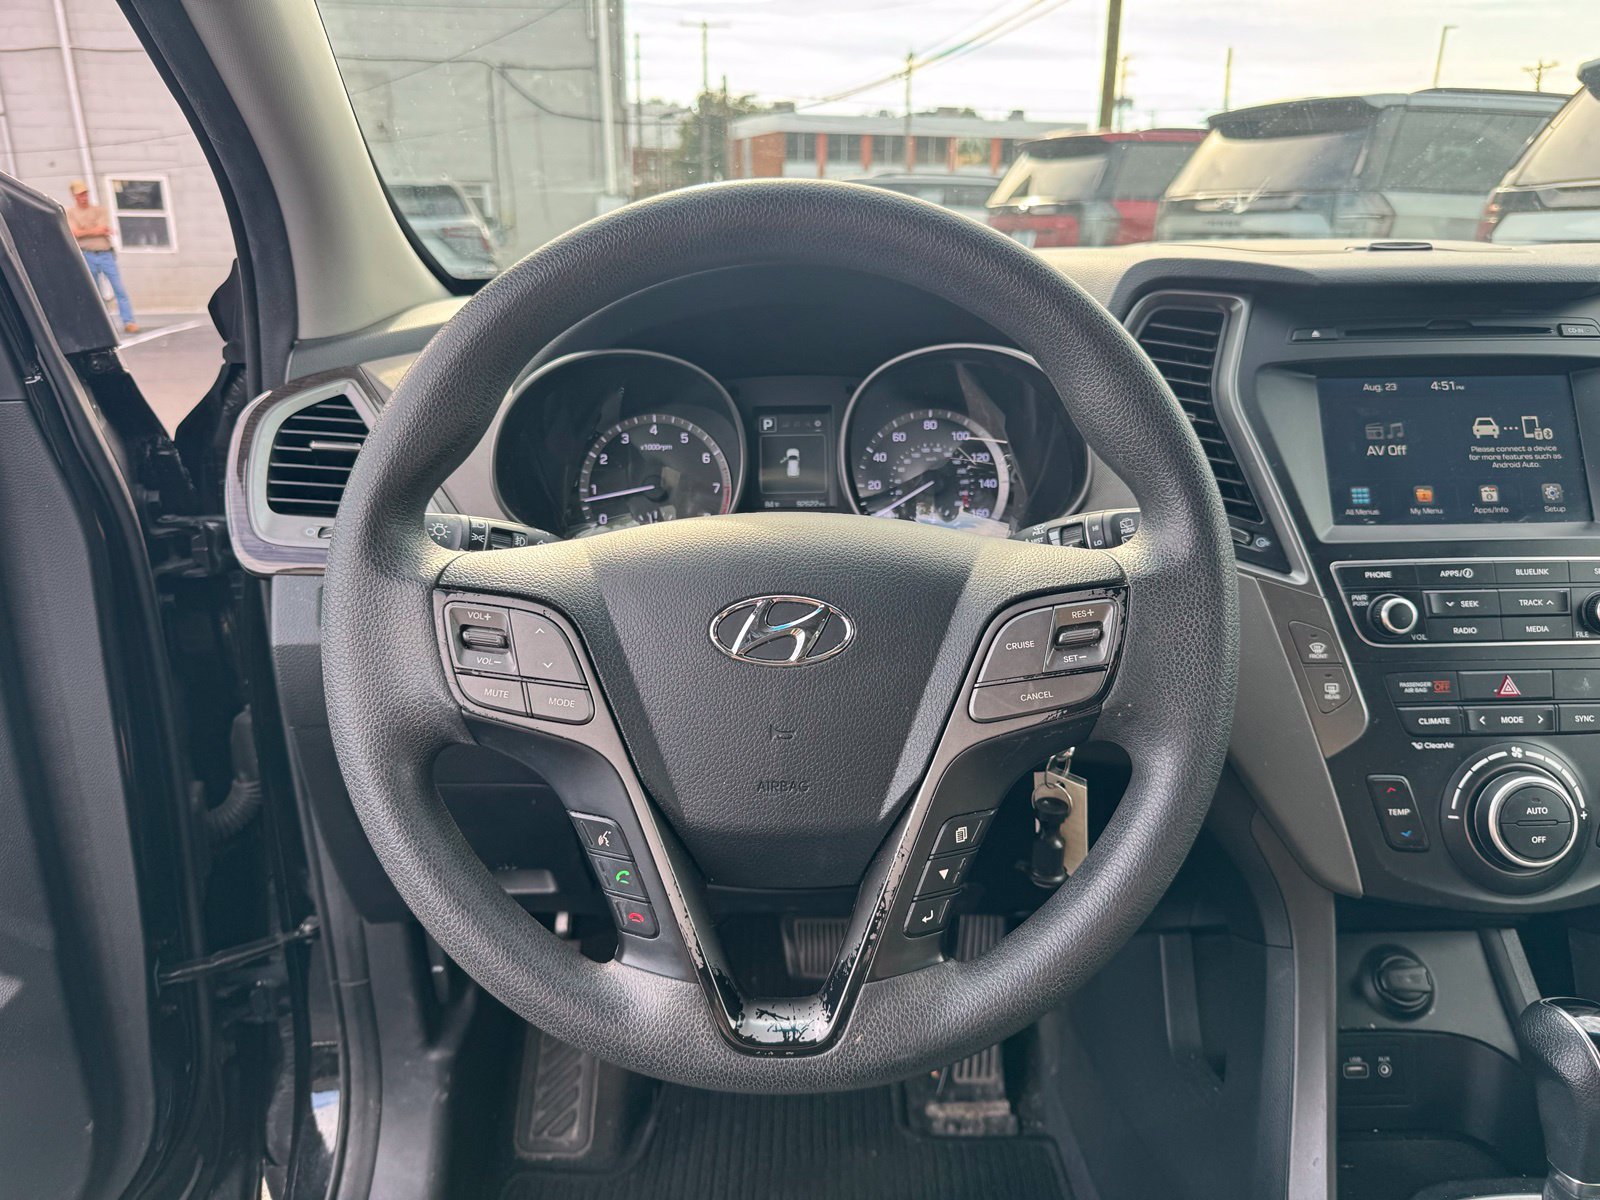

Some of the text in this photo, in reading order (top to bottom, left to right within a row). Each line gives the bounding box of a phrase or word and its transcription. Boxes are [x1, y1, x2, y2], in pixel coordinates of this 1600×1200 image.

[1362, 383, 1398, 393] Aug. 23
[1430, 381, 1455, 391] 4:51
[650, 425, 657, 435] 4
[763, 419, 773, 431] P
[923, 420, 938, 430] 80
[621, 433, 630, 444] 3
[680, 433, 689, 444] 5
[892, 432, 907, 442] 60
[951, 431, 970, 441] 100
[1366, 445, 1407, 456] AV Off
[600, 454, 608, 465] 2
[702, 452, 711, 463] 6
[873, 452, 887, 462] 40
[971, 453, 990, 462] 120
[868, 481, 881, 491] 20
[979, 478, 997, 488] 140
[591, 484, 597, 495] 1
[712, 483, 721, 494] 7
[1544, 505, 1566, 513] Setup
[599, 513, 608, 525] 0
[1364, 571, 1392, 579] PHONE
[1515, 568, 1549, 576] BLUELINK
[1460, 600, 1479, 608] SEEK
[1525, 625, 1549, 633] MEDIA
[1005, 640, 1035, 651] CRUISE
[1434, 682, 1450, 691] OFF
[484, 688, 509, 699] MUTE
[1020, 691, 1054, 702] CANCEL
[548, 697, 576, 708] MODE
[1418, 717, 1451, 725] CLIMATE
[1500, 716, 1524, 724] MODE
[1574, 715, 1595, 723] SYNC
[756, 781, 810, 793] AIRBAG
[1387, 808, 1411, 816] TEMP
[1526, 806, 1549, 815] AUTO
[1531, 836, 1546, 844] OFF
